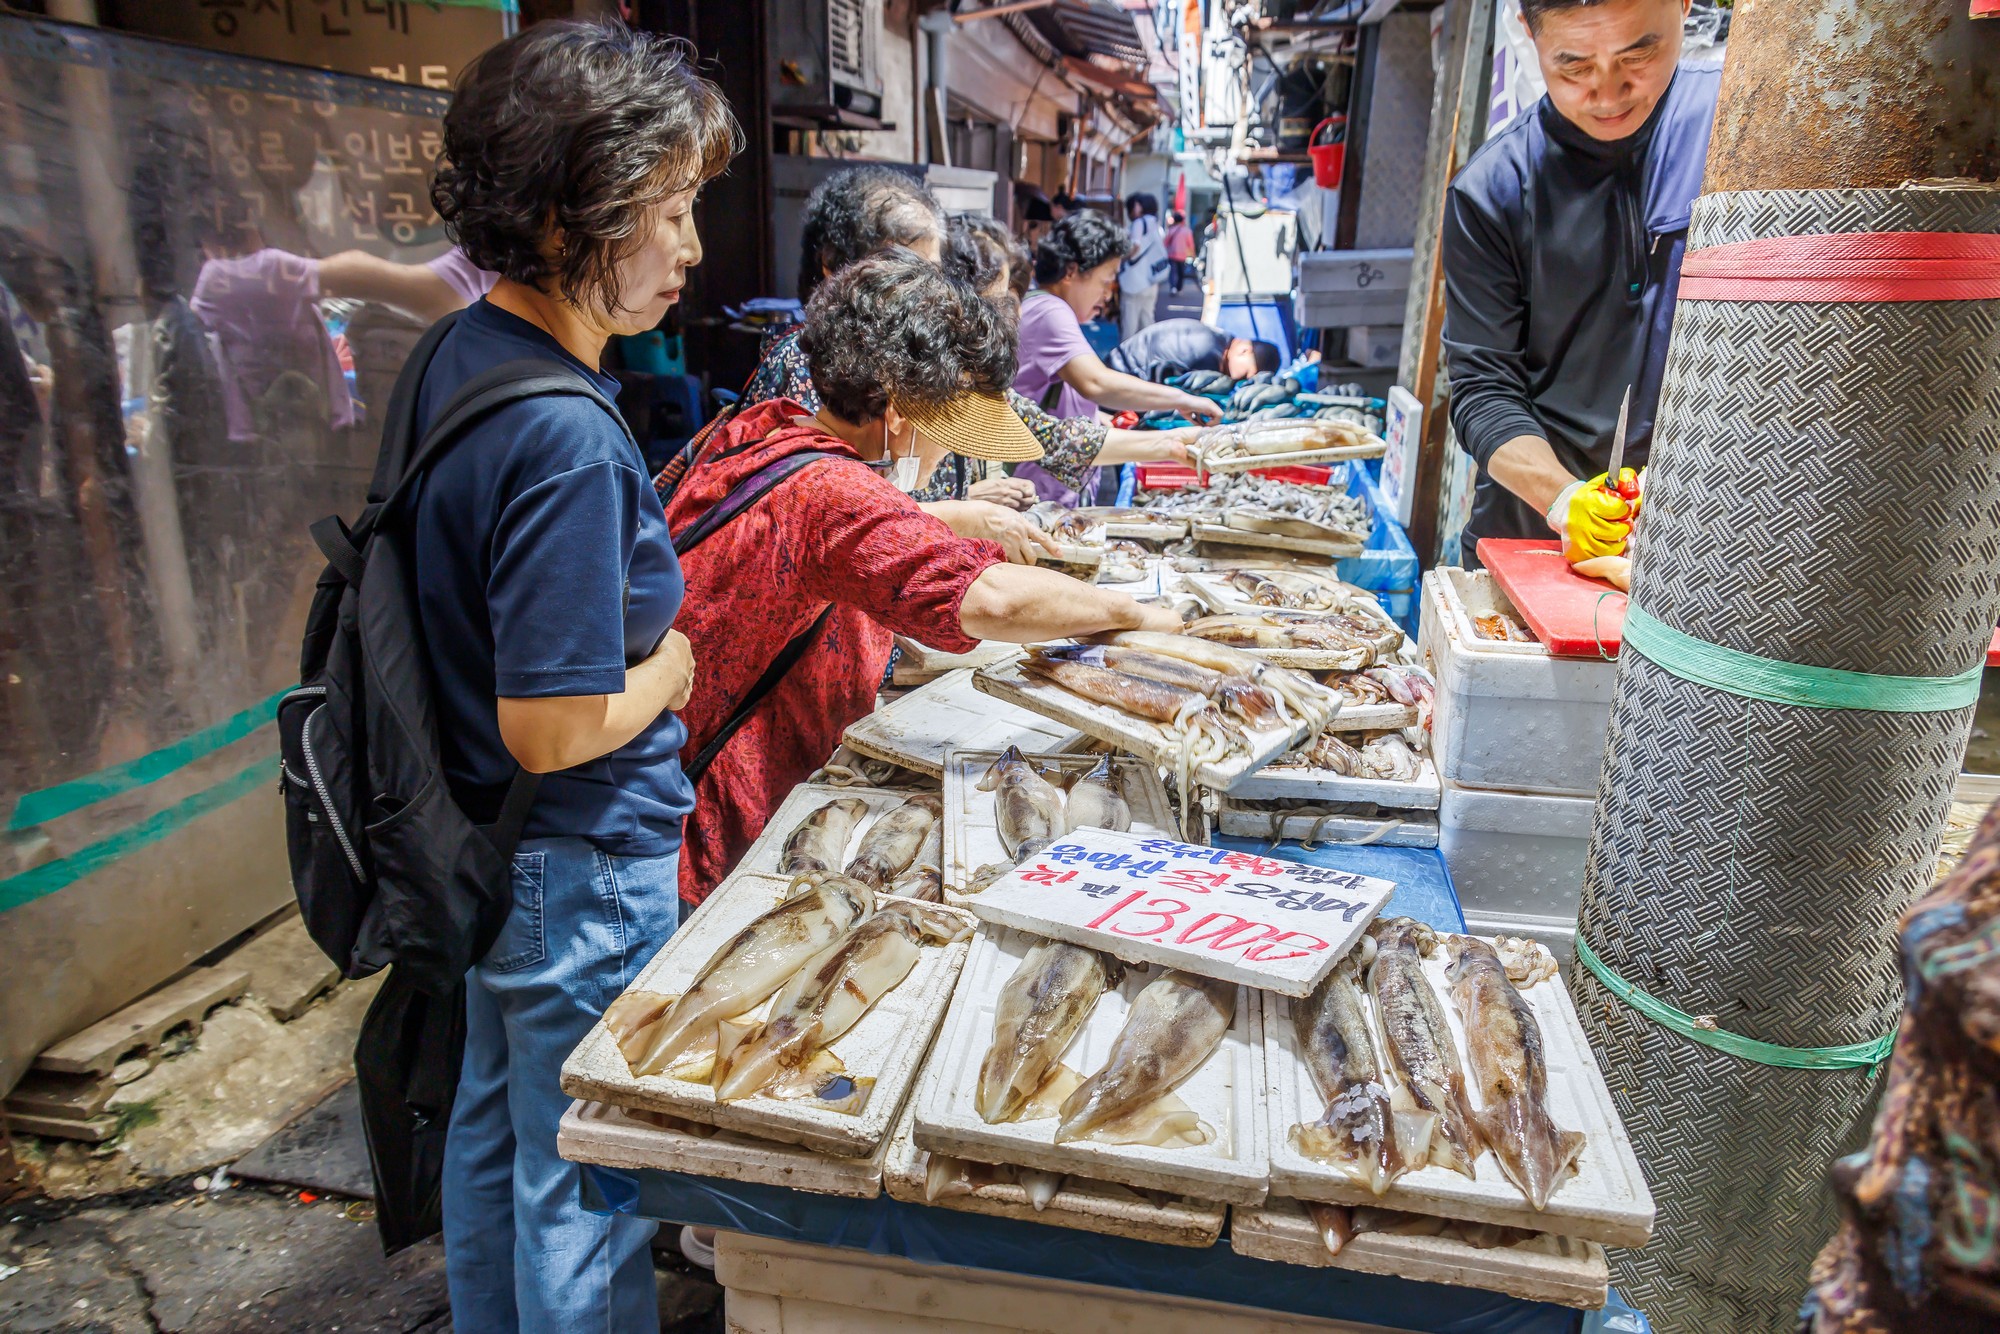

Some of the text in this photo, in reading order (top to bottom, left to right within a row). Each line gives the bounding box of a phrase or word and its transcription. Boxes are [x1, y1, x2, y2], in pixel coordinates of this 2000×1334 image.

[1015, 864, 1122, 899] 한 판
[1225, 882, 1370, 923] 오징어
